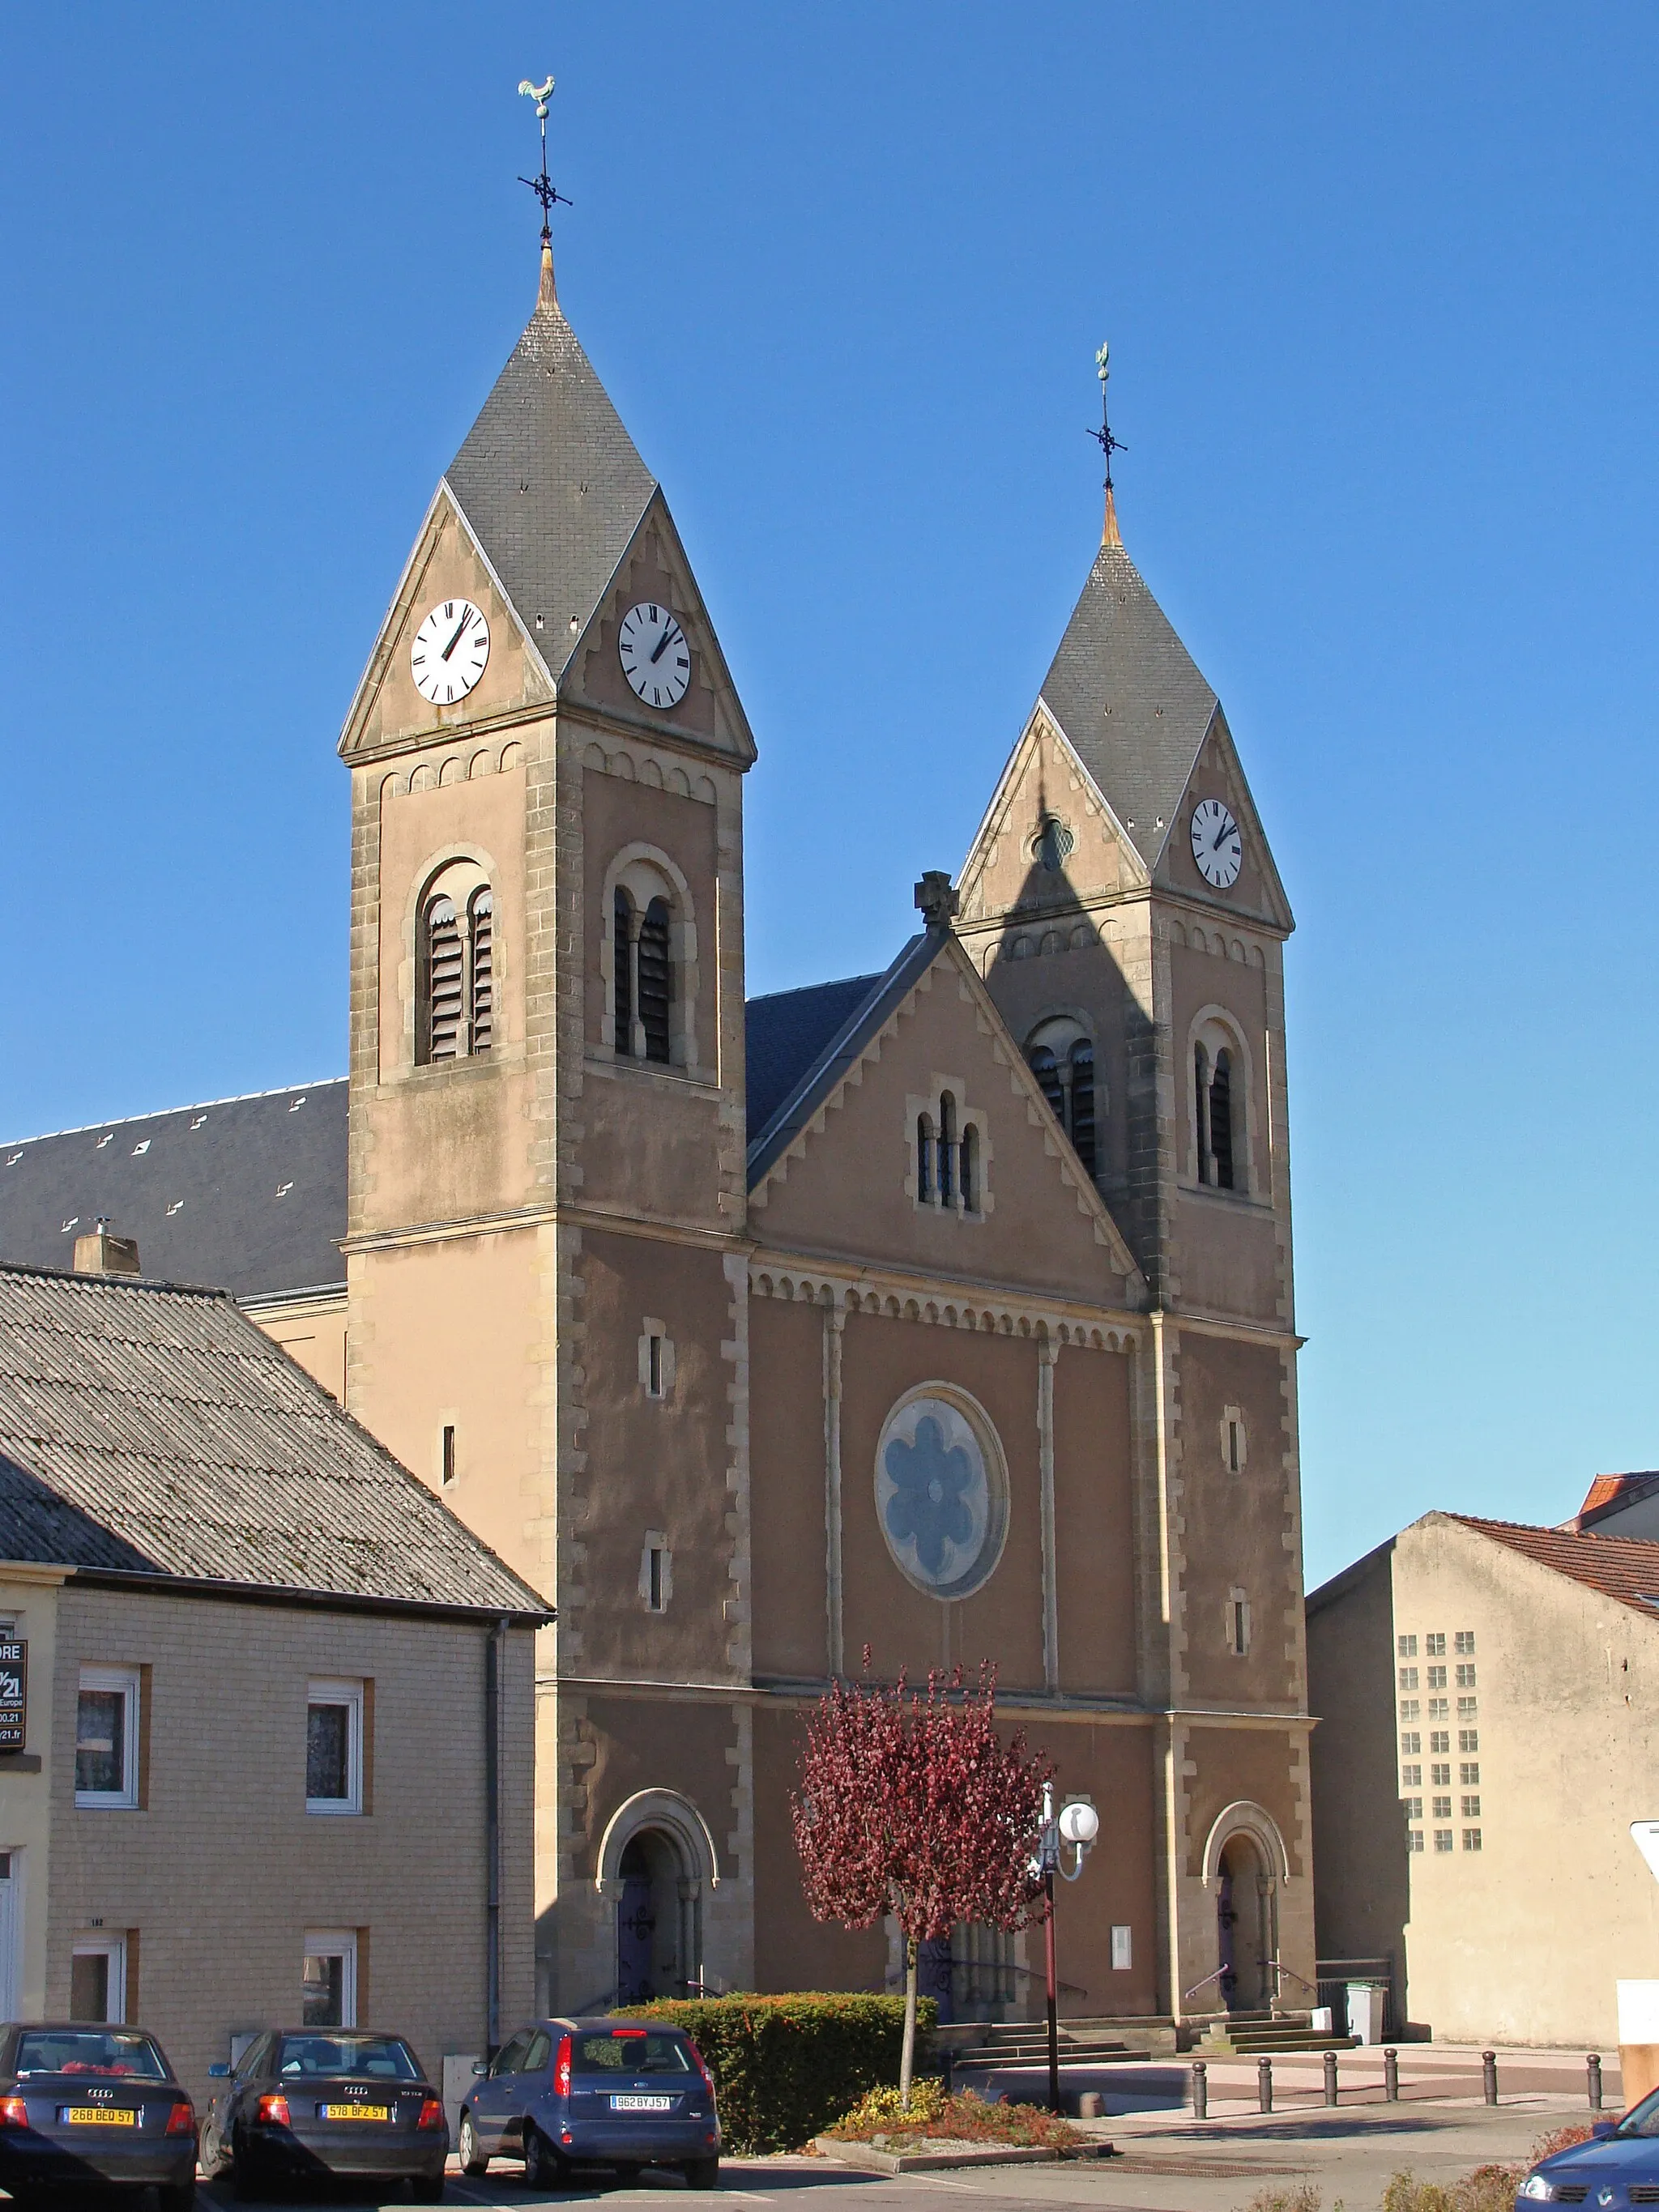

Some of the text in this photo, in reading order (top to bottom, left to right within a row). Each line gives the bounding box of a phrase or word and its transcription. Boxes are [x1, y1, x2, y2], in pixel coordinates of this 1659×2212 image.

[2, 1678, 19, 1698] 21
[618, 2097, 667, 2108] 962 BYJ 57
[72, 2109, 93, 2120] 268
[118, 2111, 130, 2122] 57
[330, 2106, 384, 2116] 578 BFZ 57
